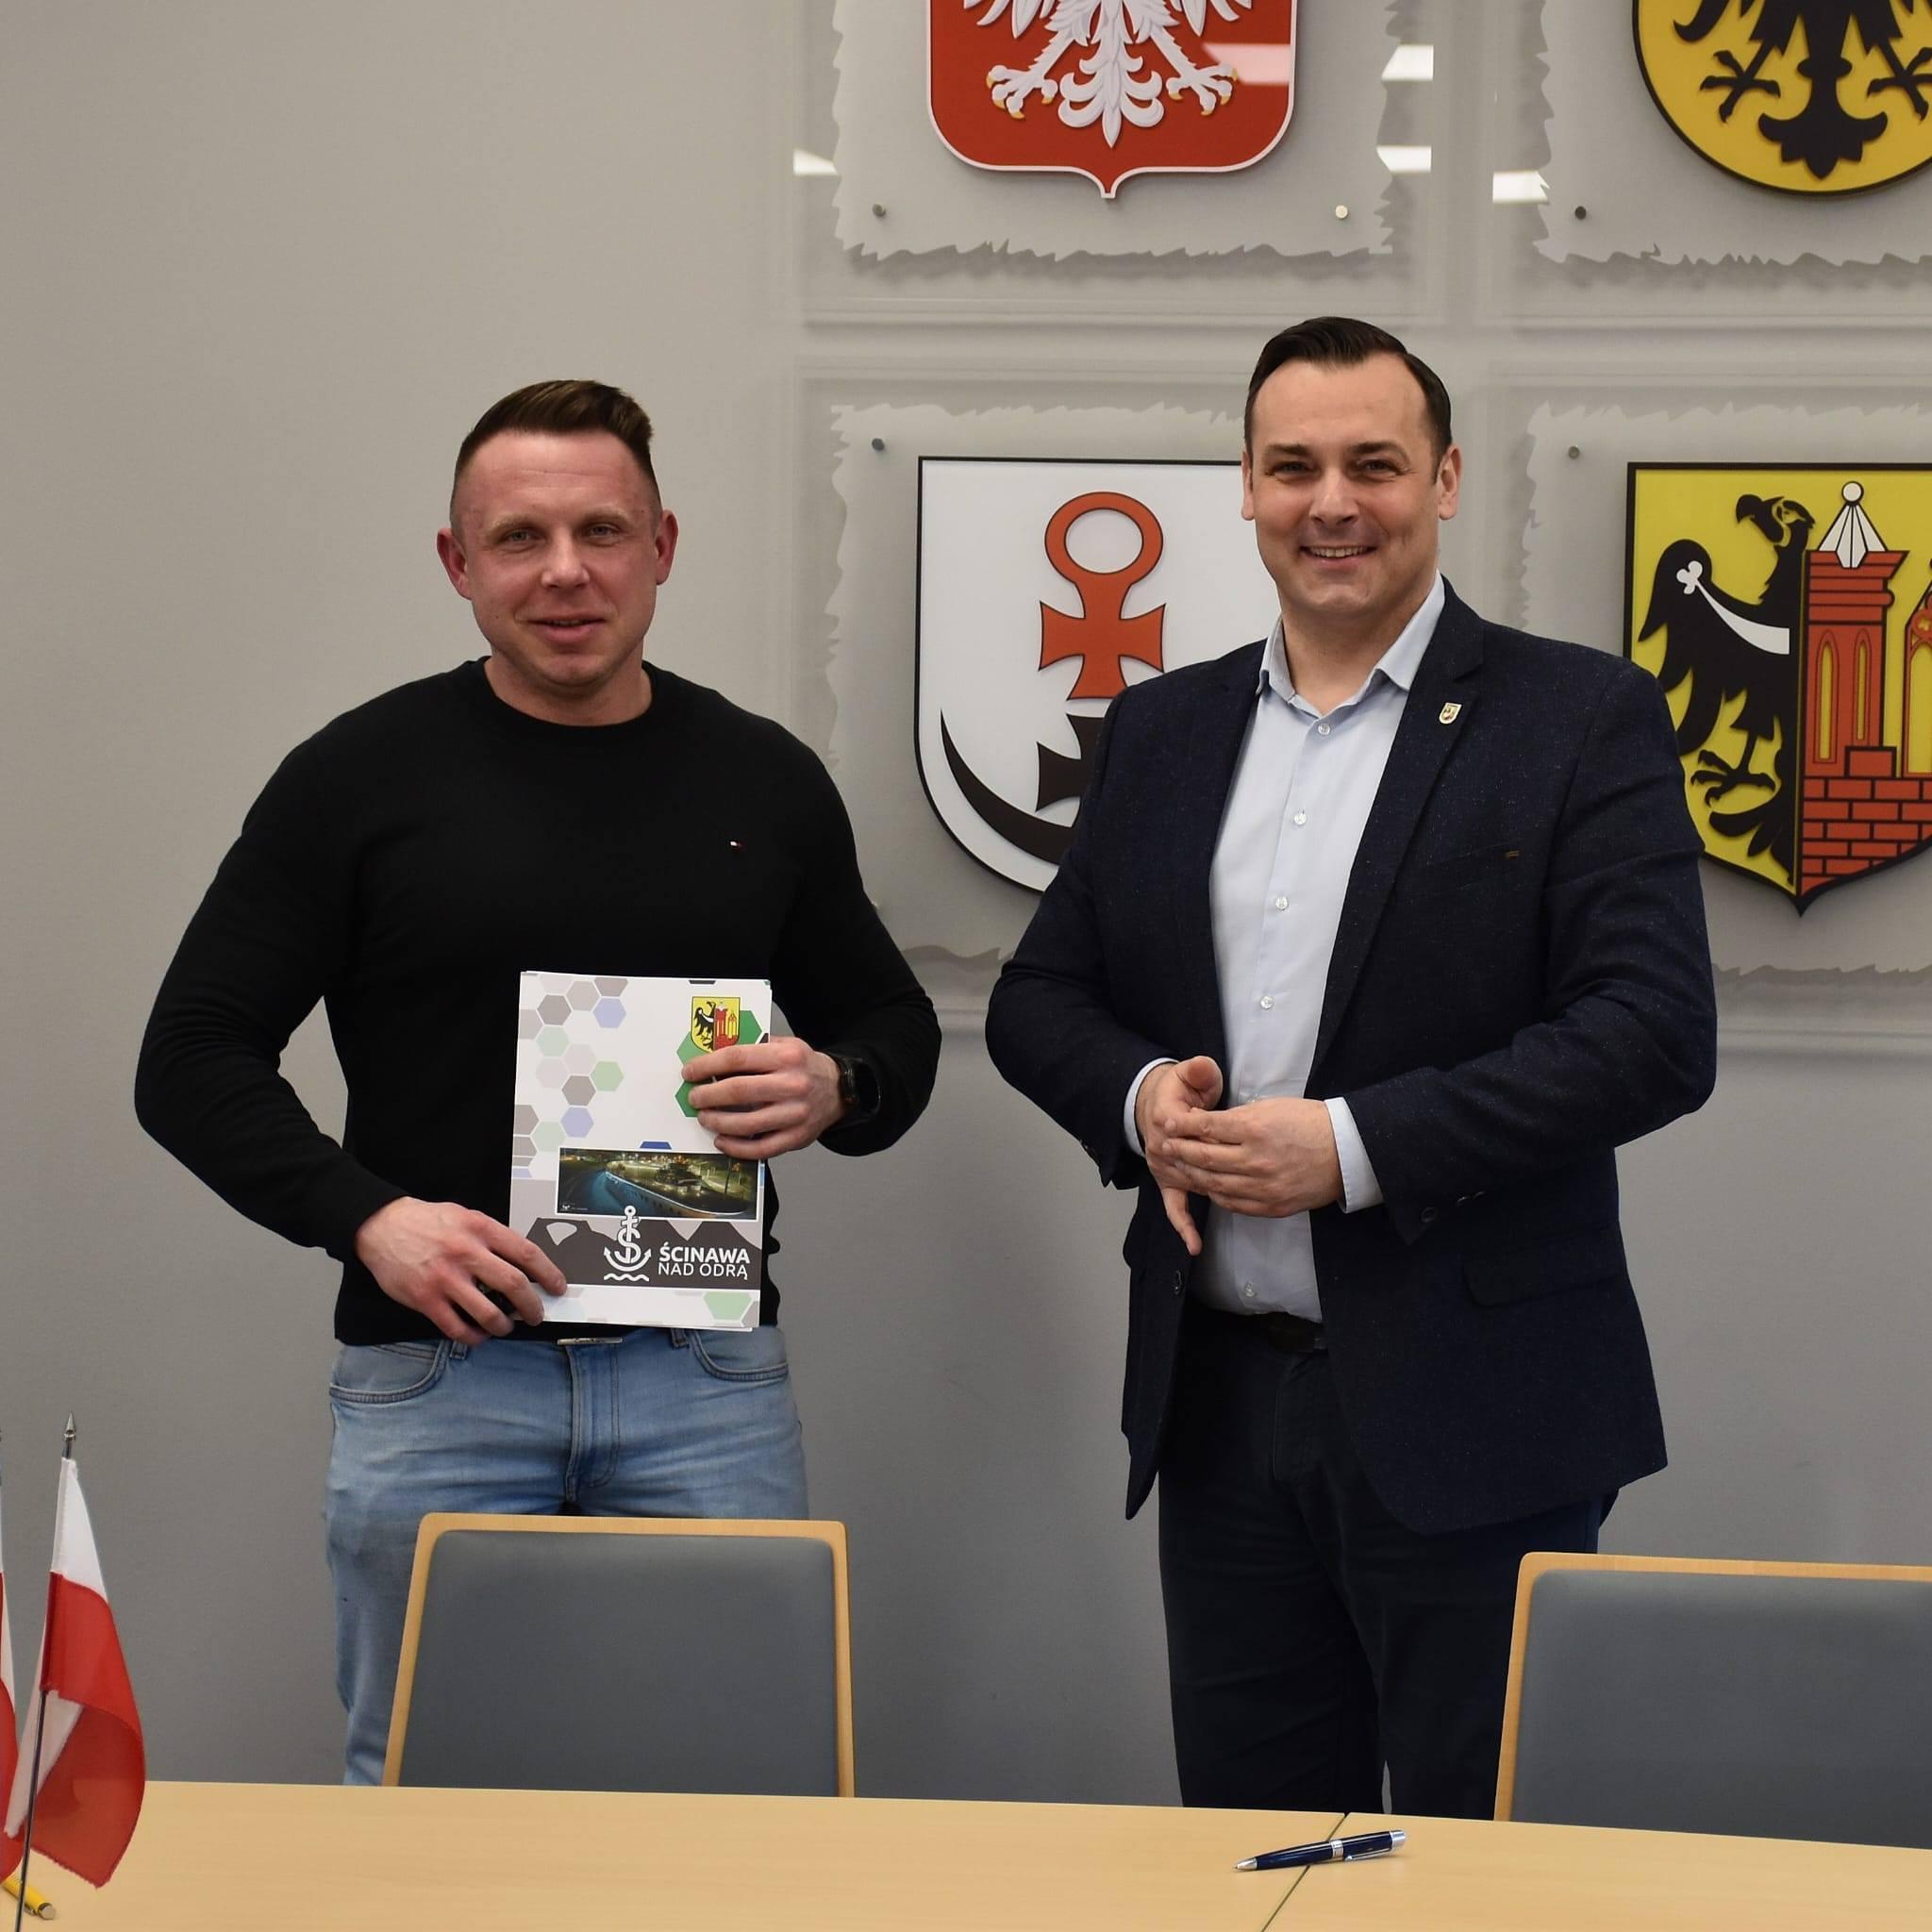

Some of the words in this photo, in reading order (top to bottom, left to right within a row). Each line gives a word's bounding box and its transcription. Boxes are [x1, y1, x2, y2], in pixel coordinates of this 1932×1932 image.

[659, 1241, 750, 1264] ŚCINAWA
[658, 1262, 694, 1276] NAD
[699, 1263, 748, 1280] ODRĄ
